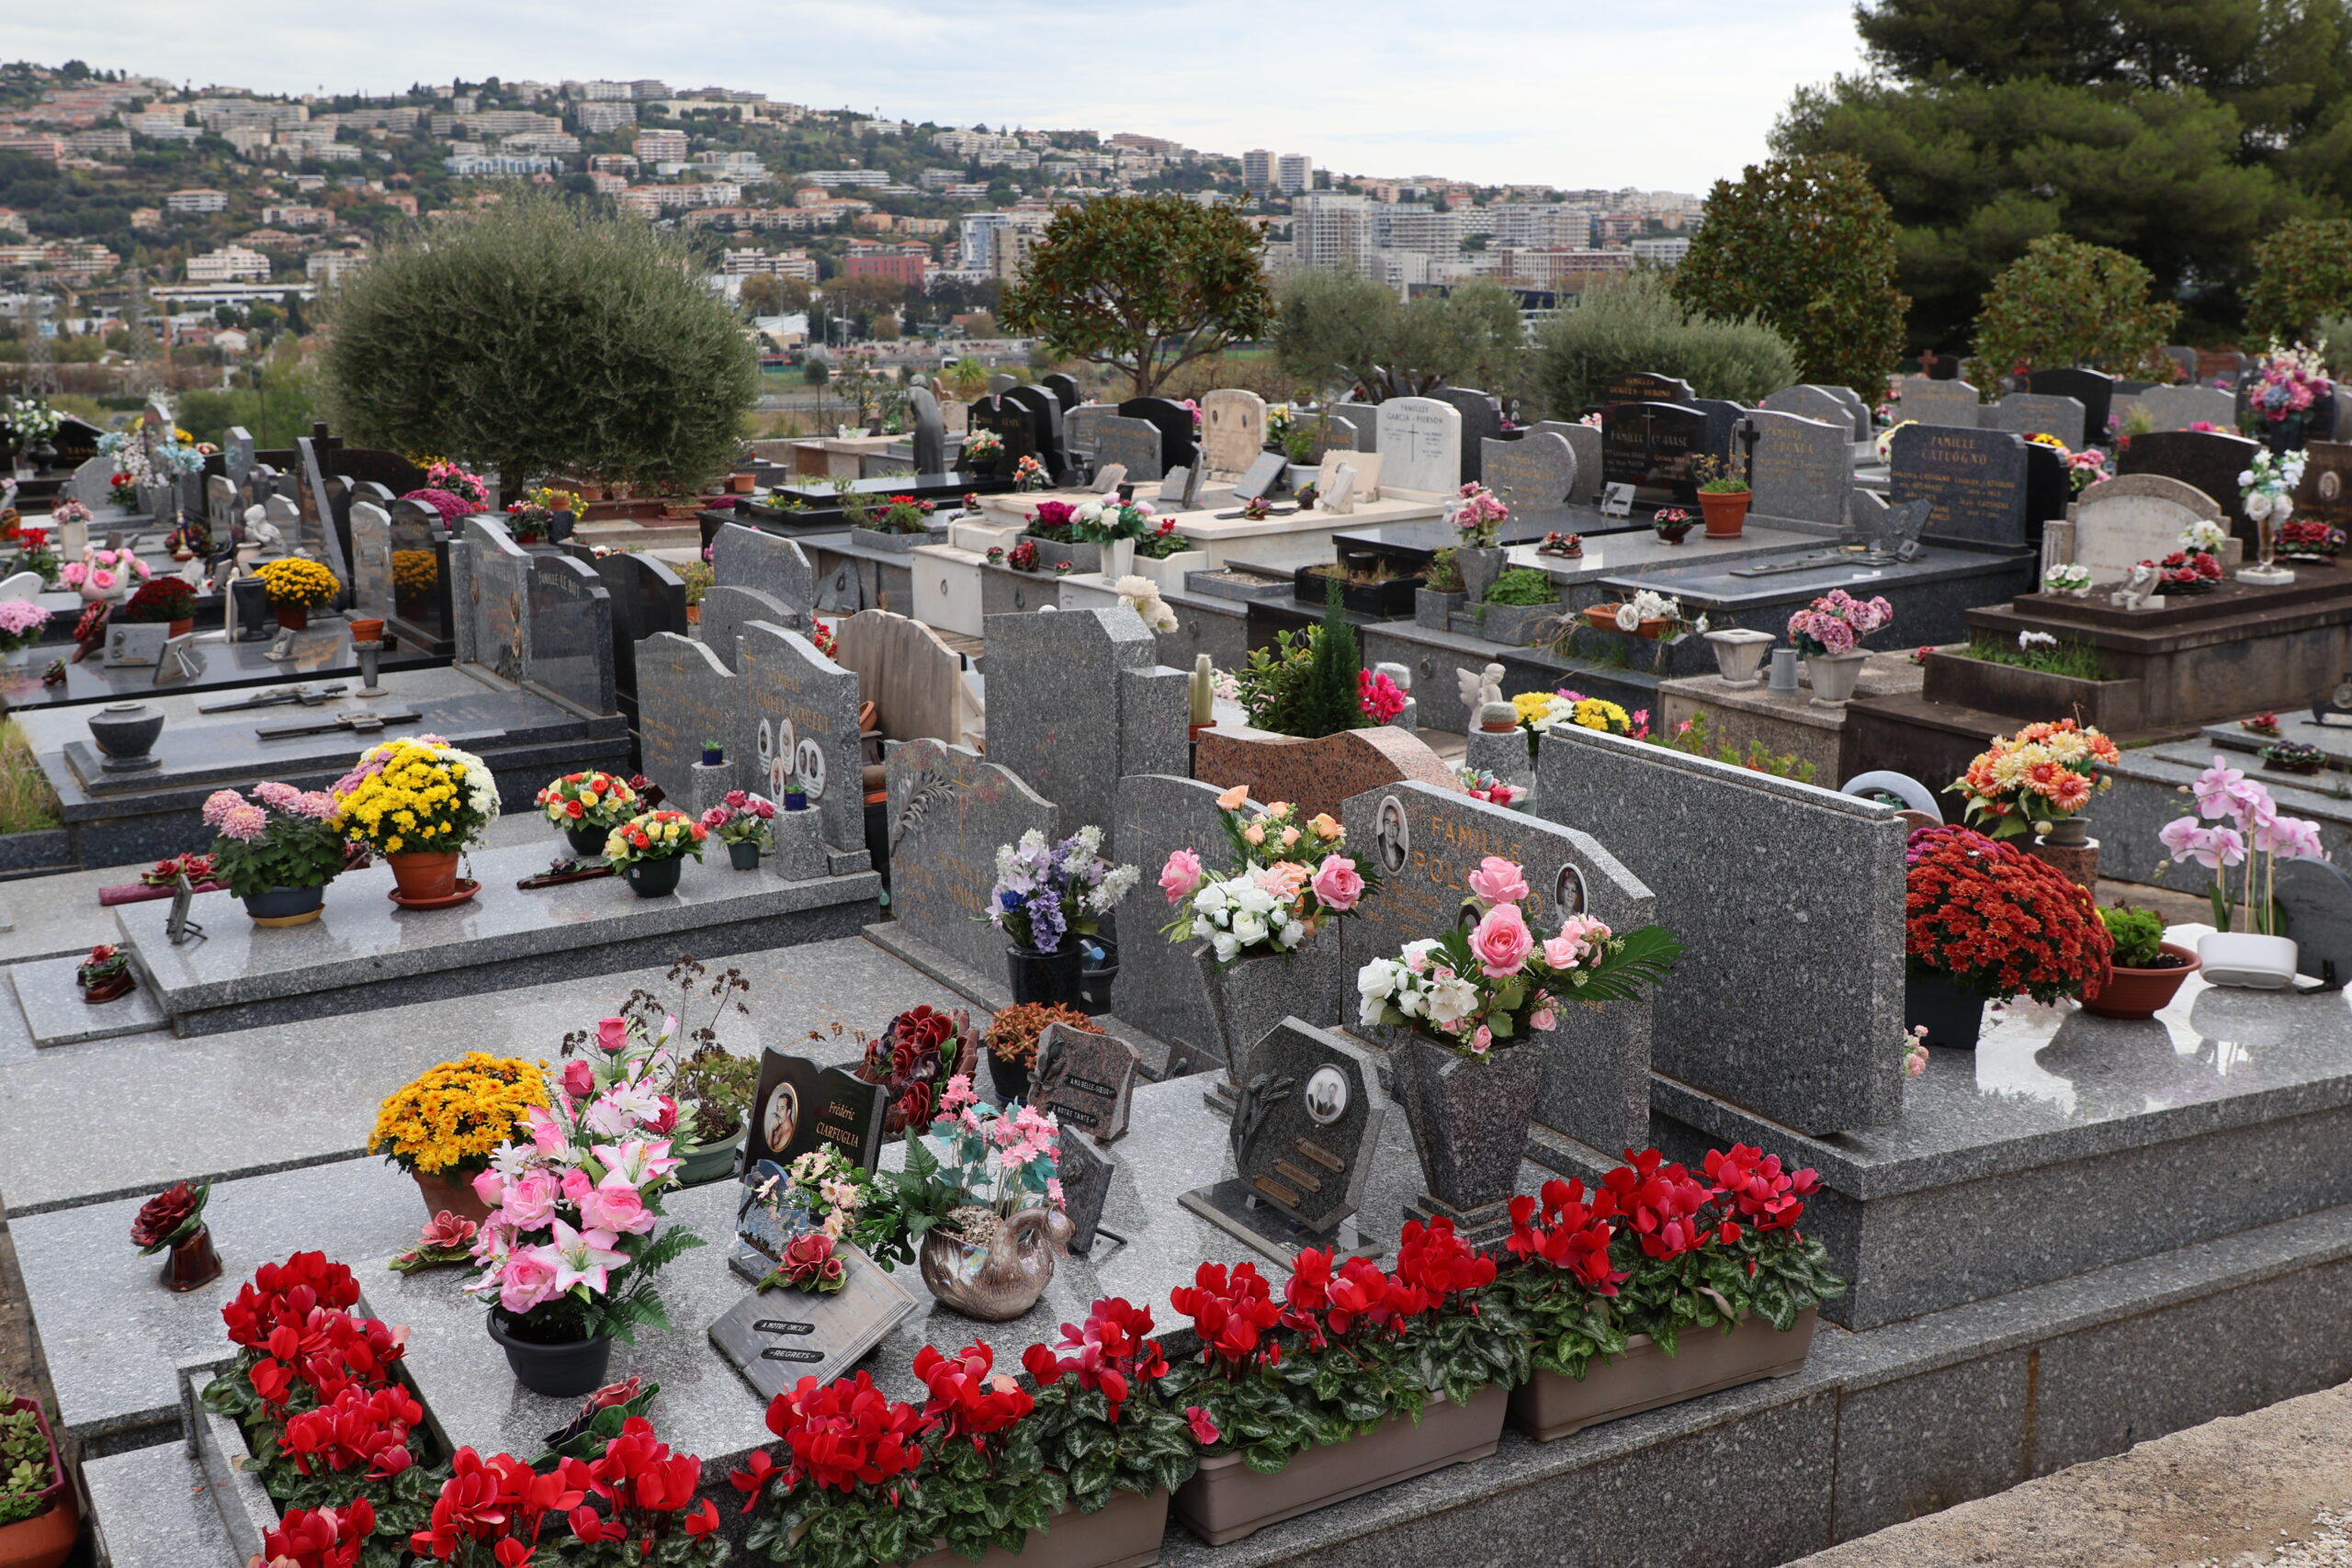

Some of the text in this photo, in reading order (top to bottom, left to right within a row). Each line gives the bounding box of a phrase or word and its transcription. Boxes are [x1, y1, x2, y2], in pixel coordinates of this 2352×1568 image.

[1401, 404, 1430, 412] FAMILLES
[1931, 435, 1976, 449] FAMILLE
[1921, 449, 1988, 465] CATUOGNO
[1431, 816, 1524, 865] FAMILLE
[829, 1100, 855, 1121] Frédéric
[1074, 1111, 1090, 1123] TANTE
[816, 1122, 860, 1147] CIARFUGLIA
[774, 1349, 811, 1359] REGRETS
